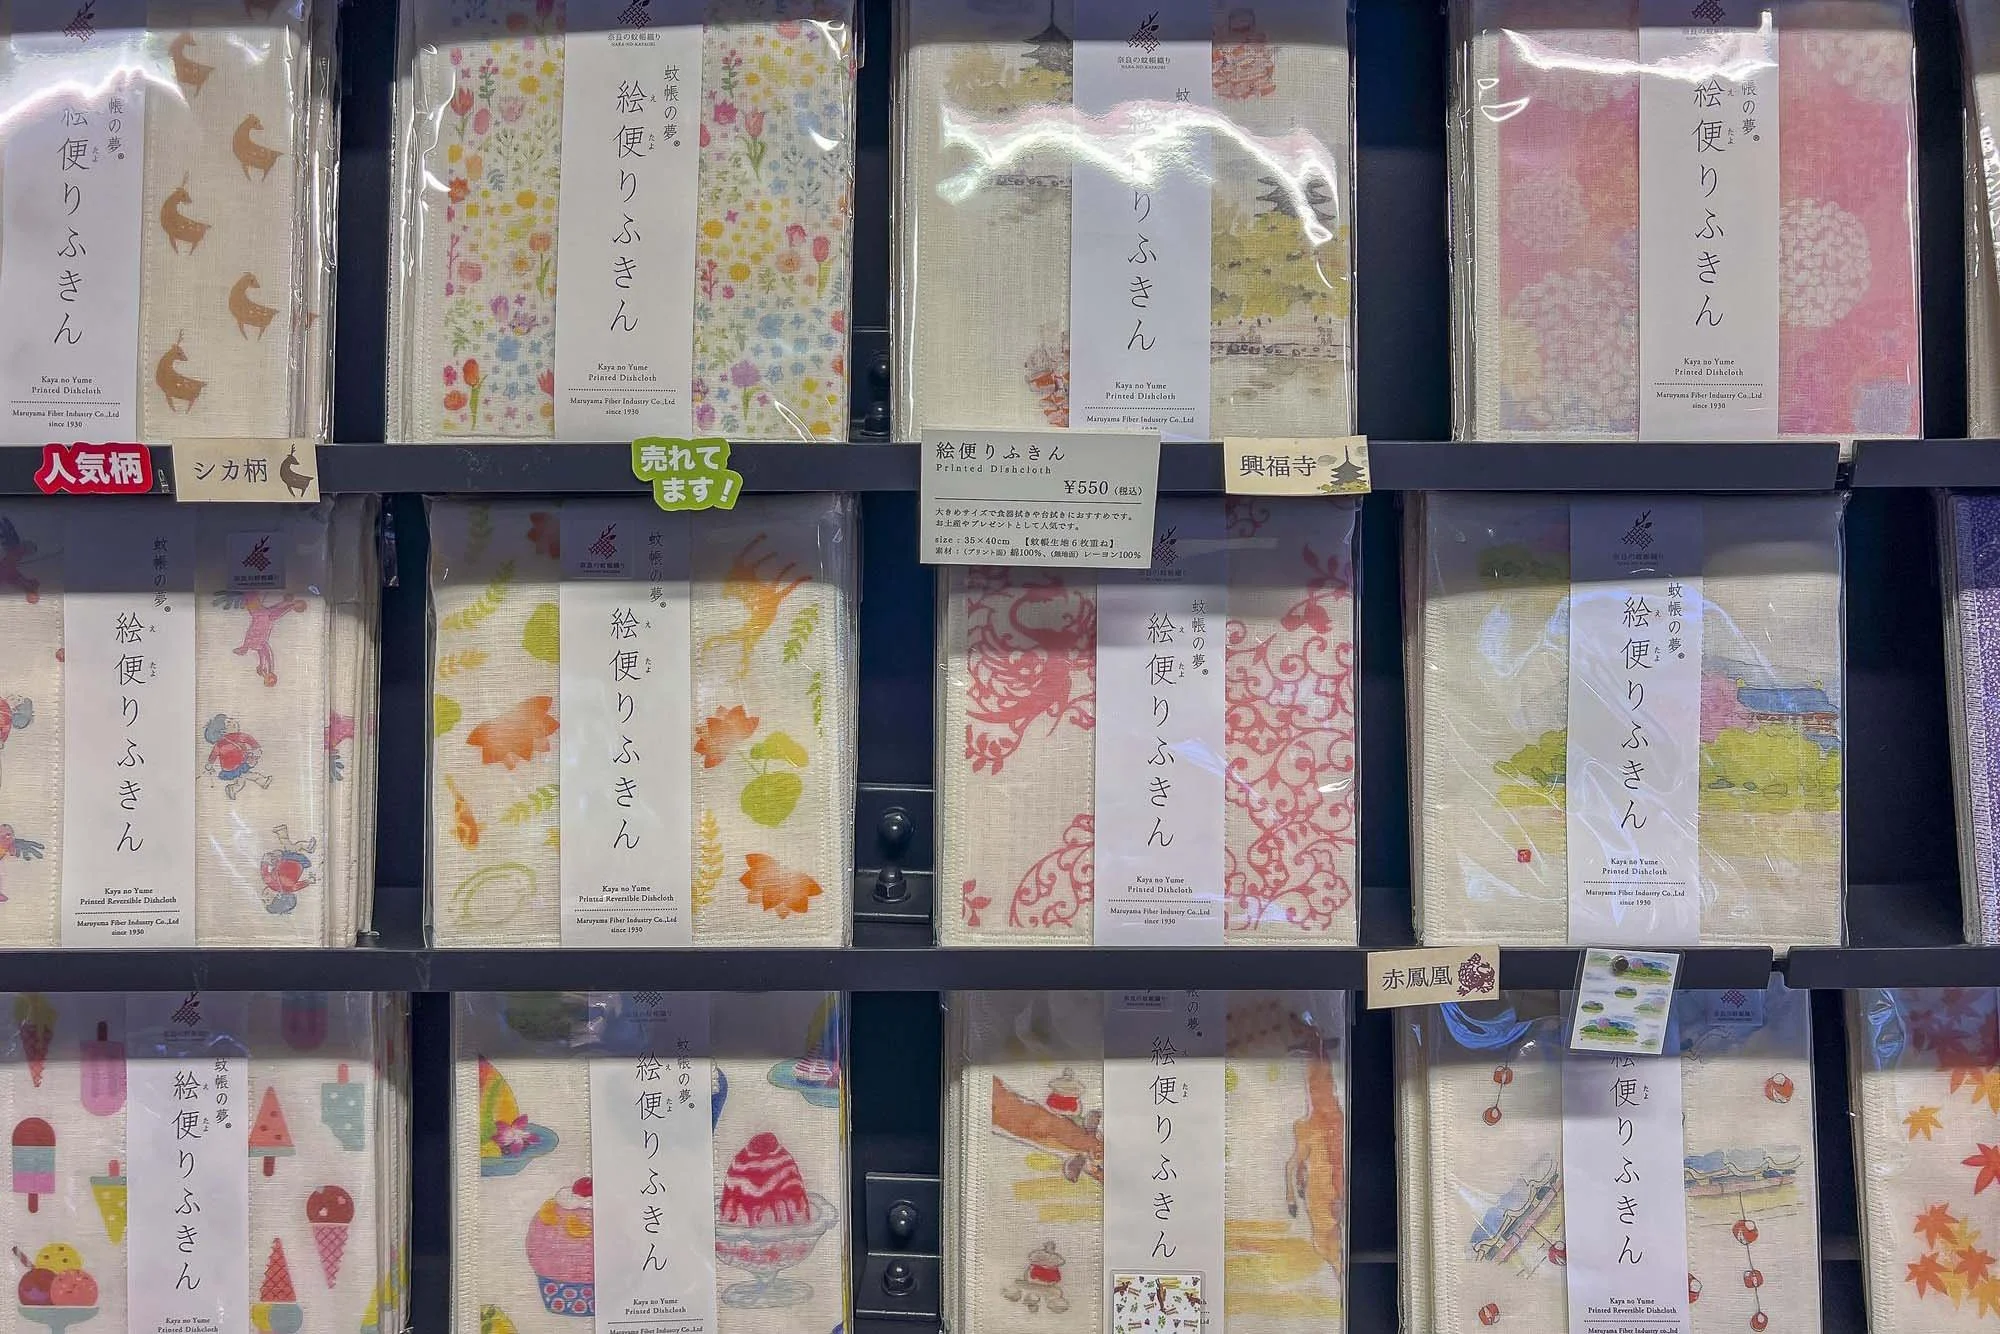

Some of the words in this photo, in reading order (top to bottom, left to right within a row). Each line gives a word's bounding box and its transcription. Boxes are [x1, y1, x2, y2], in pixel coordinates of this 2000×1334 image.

[611, 80, 648, 332] 絵便りふきん
[1692, 79, 1726, 326] 絵便りふきん
[598, 363, 615, 373] Kaya
[629, 364, 649, 372] Yume
[1684, 358, 1701, 366] Kaya
[1714, 358, 1735, 366] Yume
[42, 376, 58, 385] Kaya
[72, 376, 93, 384] Yume
[589, 374, 617, 382] Printed
[620, 374, 657, 382] Dishcloth
[1115, 382, 1133, 391] Kaya
[1146, 382, 1167, 390] Yume
[570, 398, 603, 407] Maruyama
[604, 398, 621, 406] Fiber
[623, 398, 649, 407] Industry
[1656, 392, 1690, 400] Maruyama
[1709, 392, 1736, 400] Industry
[12, 410, 45, 418] Maruyama
[66, 411, 96, 419] Industry
[623, 408, 640, 416] 1930
[1087, 416, 1120, 425] Maruyama
[1140, 416, 1168, 425] Industry
[936, 441, 1066, 462] 絵便りふきん
[641, 446, 721, 472] 売れて
[44, 452, 144, 485] 人気柄
[193, 458, 268, 484] シカ柄
[936, 464, 983, 473] Printed
[991, 465, 1052, 475] Dishcloth
[1240, 455, 1317, 477] 興福寺
[1064, 480, 1109, 495] ¥550
[1620, 596, 1653, 829] 絵便りふきん
[114, 611, 146, 851] 絵便りふきん
[610, 607, 641, 849] 絵便りふきん
[1146, 612, 1177, 847] 絵便りふきん
[1611, 858, 1627, 866] Kaya
[1136, 876, 1153, 884] Kaya
[77, 920, 109, 928] Maruyama
[128, 919, 154, 927] Industry
[627, 917, 652, 925] Industry
[1382, 966, 1453, 991] 赤鳳凰
[1149, 1036, 1179, 1257] 絵便りふきん
[635, 1052, 667, 1271] 絵便りふきん
[171, 1071, 201, 1290] 絵便りふきん
[633, 1299, 649, 1307] Kaya
